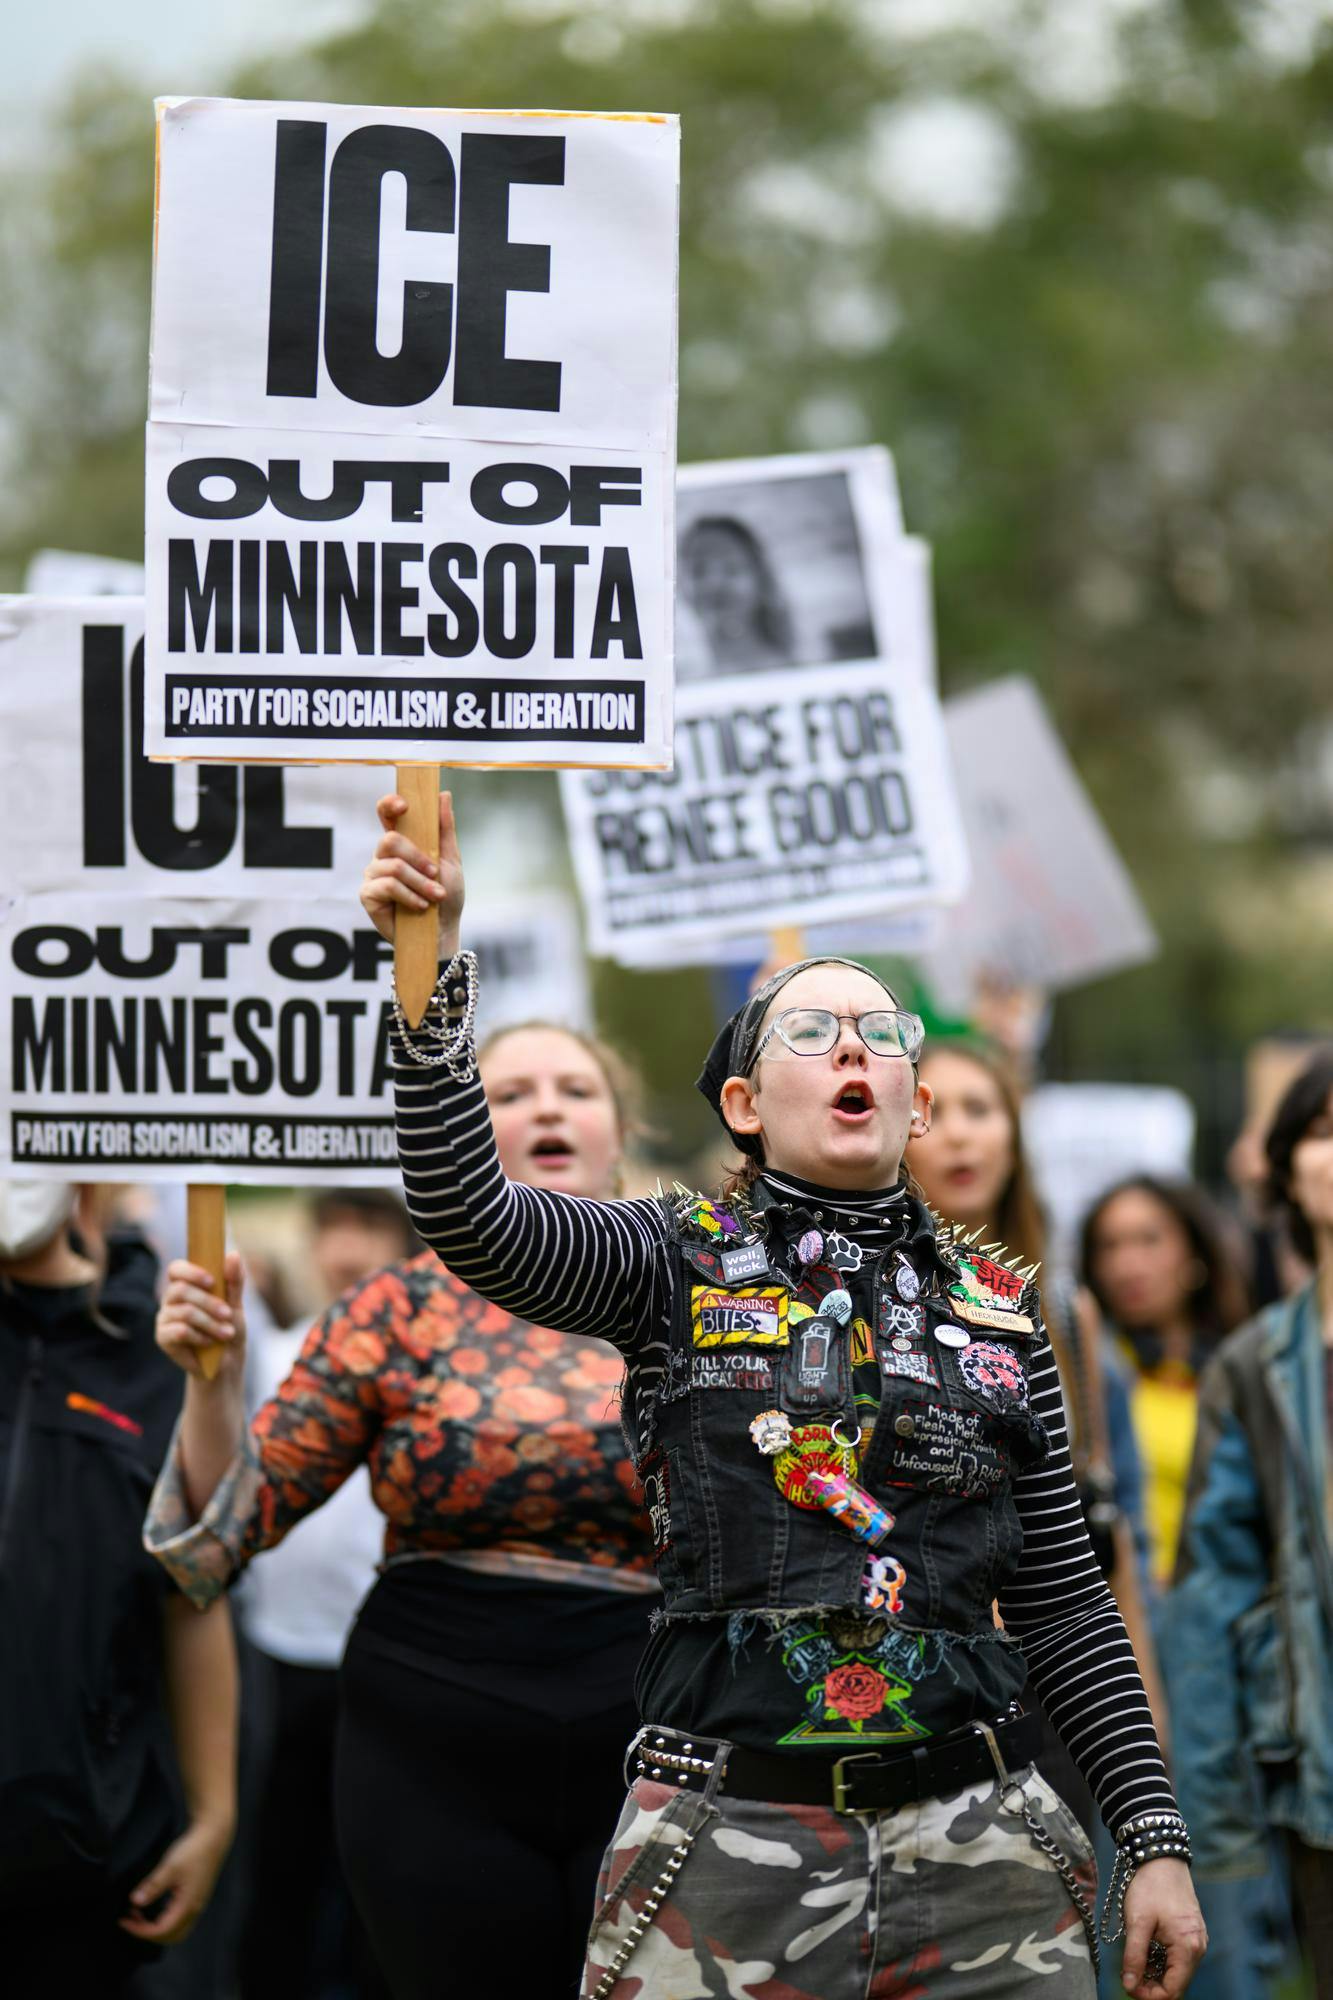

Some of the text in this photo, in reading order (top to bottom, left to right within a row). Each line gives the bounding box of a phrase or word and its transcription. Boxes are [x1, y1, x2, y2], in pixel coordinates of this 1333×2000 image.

[266, 119, 566, 413] ICE
[167, 457, 642, 526] OUT OF
[167, 538, 644, 660] MINNESOTA
[172, 687, 635, 732] PARTY FOR SOCIALISM & LIBERATION
[803, 690, 903, 765] FOR
[596, 770, 915, 876] RENEE GOOD
[11, 925, 396, 982] OUT OF
[16, 1121, 397, 1161] PARTY FOR SOCIALISM & LIBERATIO
[725, 1250, 762, 1267] well,
[727, 1262, 766, 1277] fuck.
[717, 1295, 776, 1313] WARNING
[701, 1308, 756, 1334] BITES
[691, 1354, 771, 1373] KILL YOUR
[691, 1370, 736, 1389] LOCAL
[798, 1371, 829, 1382] LIGHT
[928, 1404, 982, 1428] Made of
[892, 1449, 957, 1474] Unfocused
[929, 1445, 955, 1458] and
